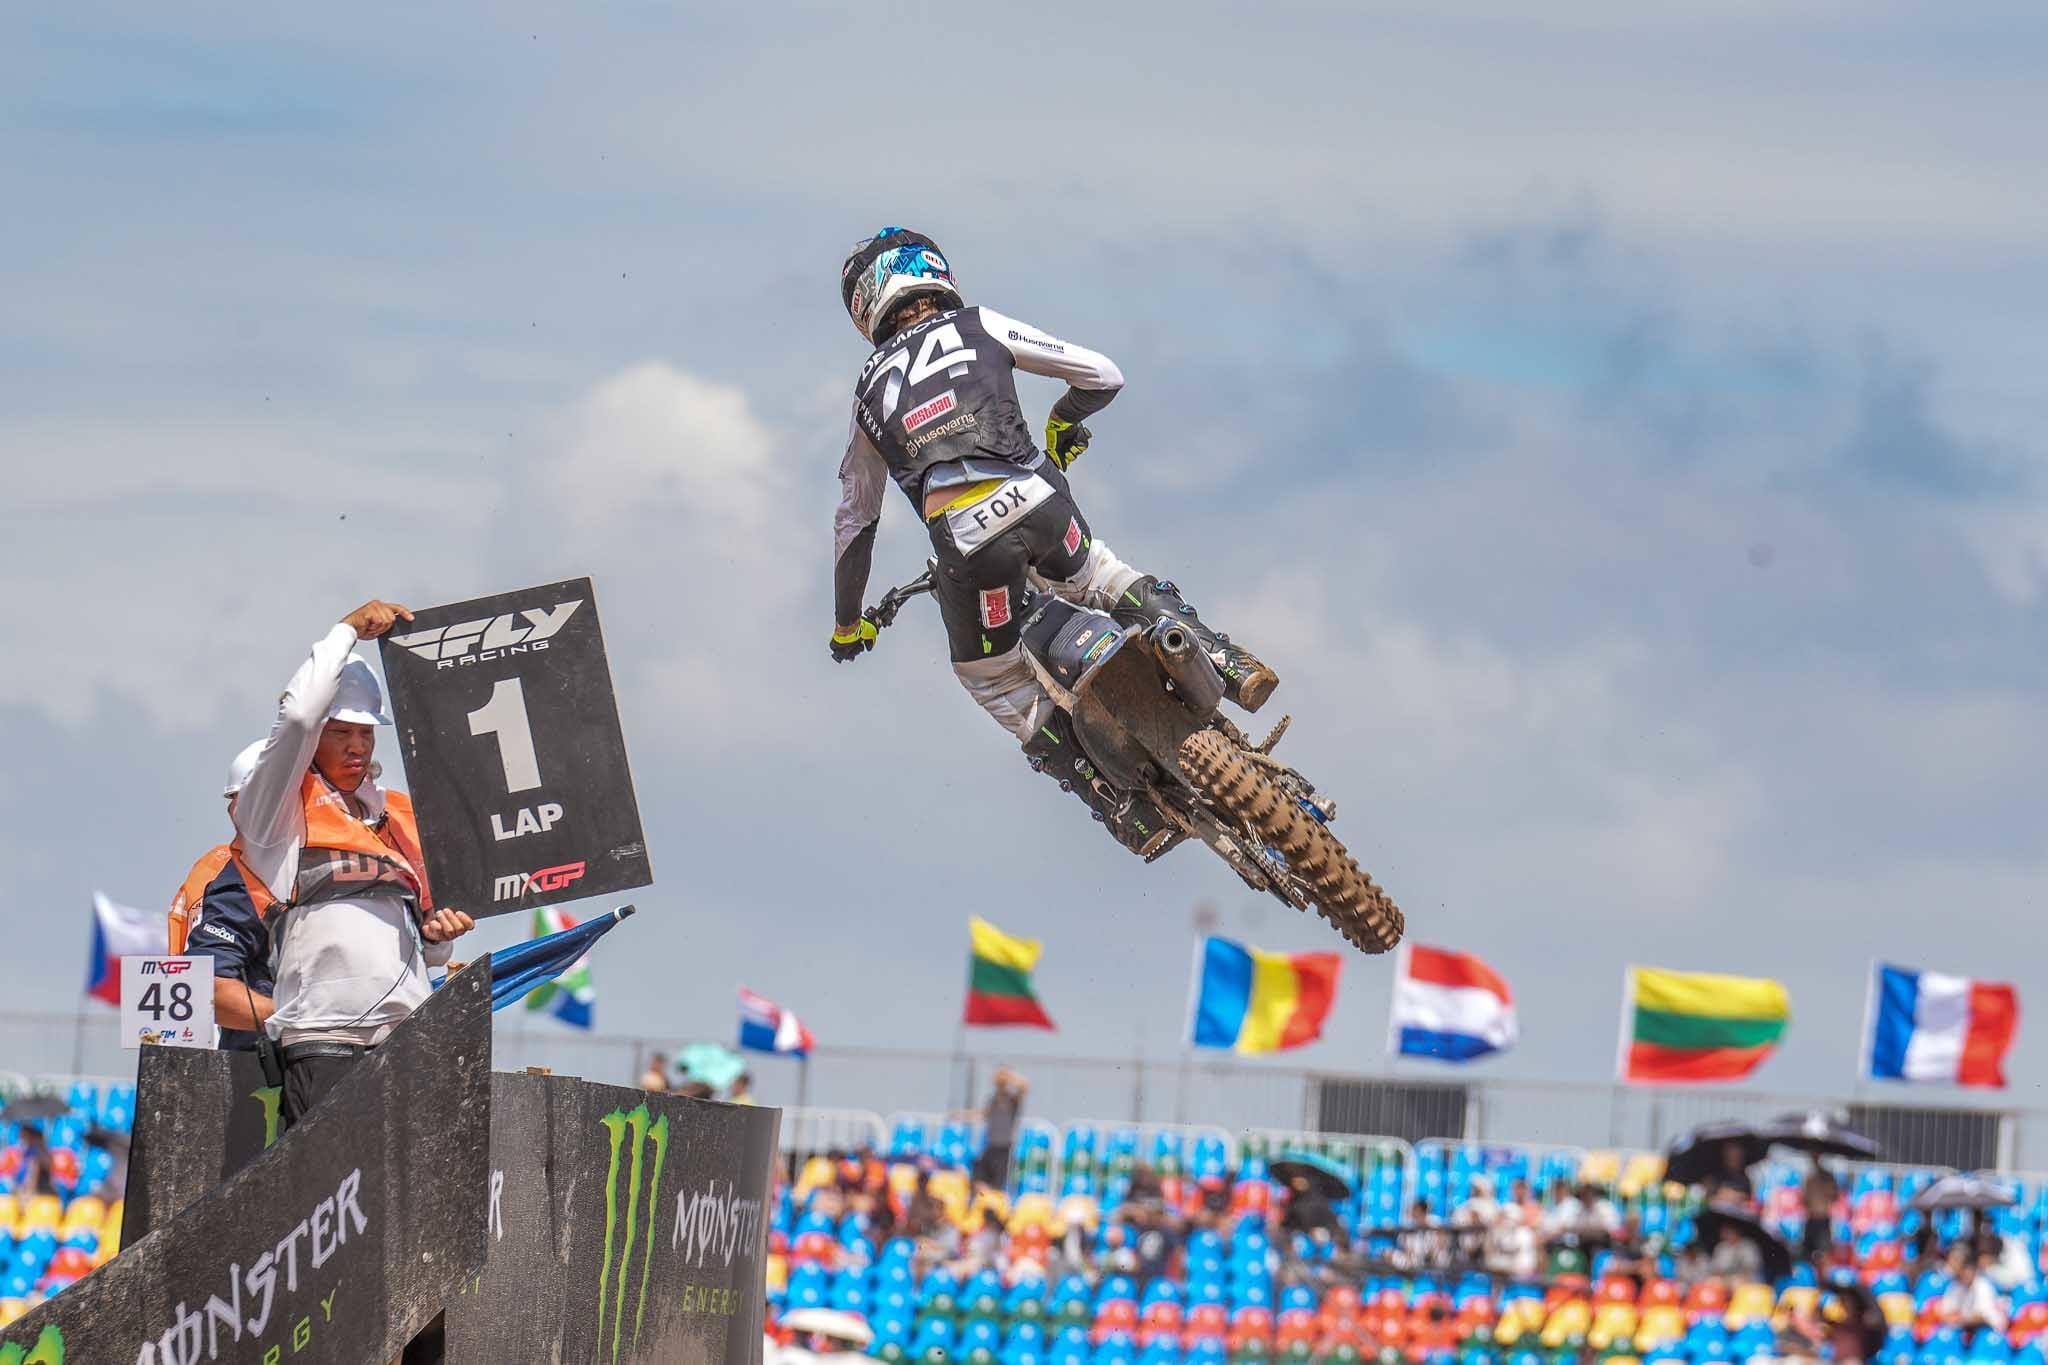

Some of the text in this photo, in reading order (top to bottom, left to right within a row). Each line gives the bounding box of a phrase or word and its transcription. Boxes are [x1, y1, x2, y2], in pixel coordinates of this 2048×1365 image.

[862, 350, 885, 381] DE
[915, 412, 976, 449] Husqvarna
[973, 485, 1028, 531] FOX
[388, 599, 584, 661] FLY
[437, 639, 549, 670] RACING
[467, 676, 543, 794] 1
[490, 802, 565, 842] LAP
[494, 860, 586, 902] MXGP
[141, 960, 192, 975] MXGP
[137, 982, 193, 1021] 48
[136, 1167, 368, 1365] ONSTER
